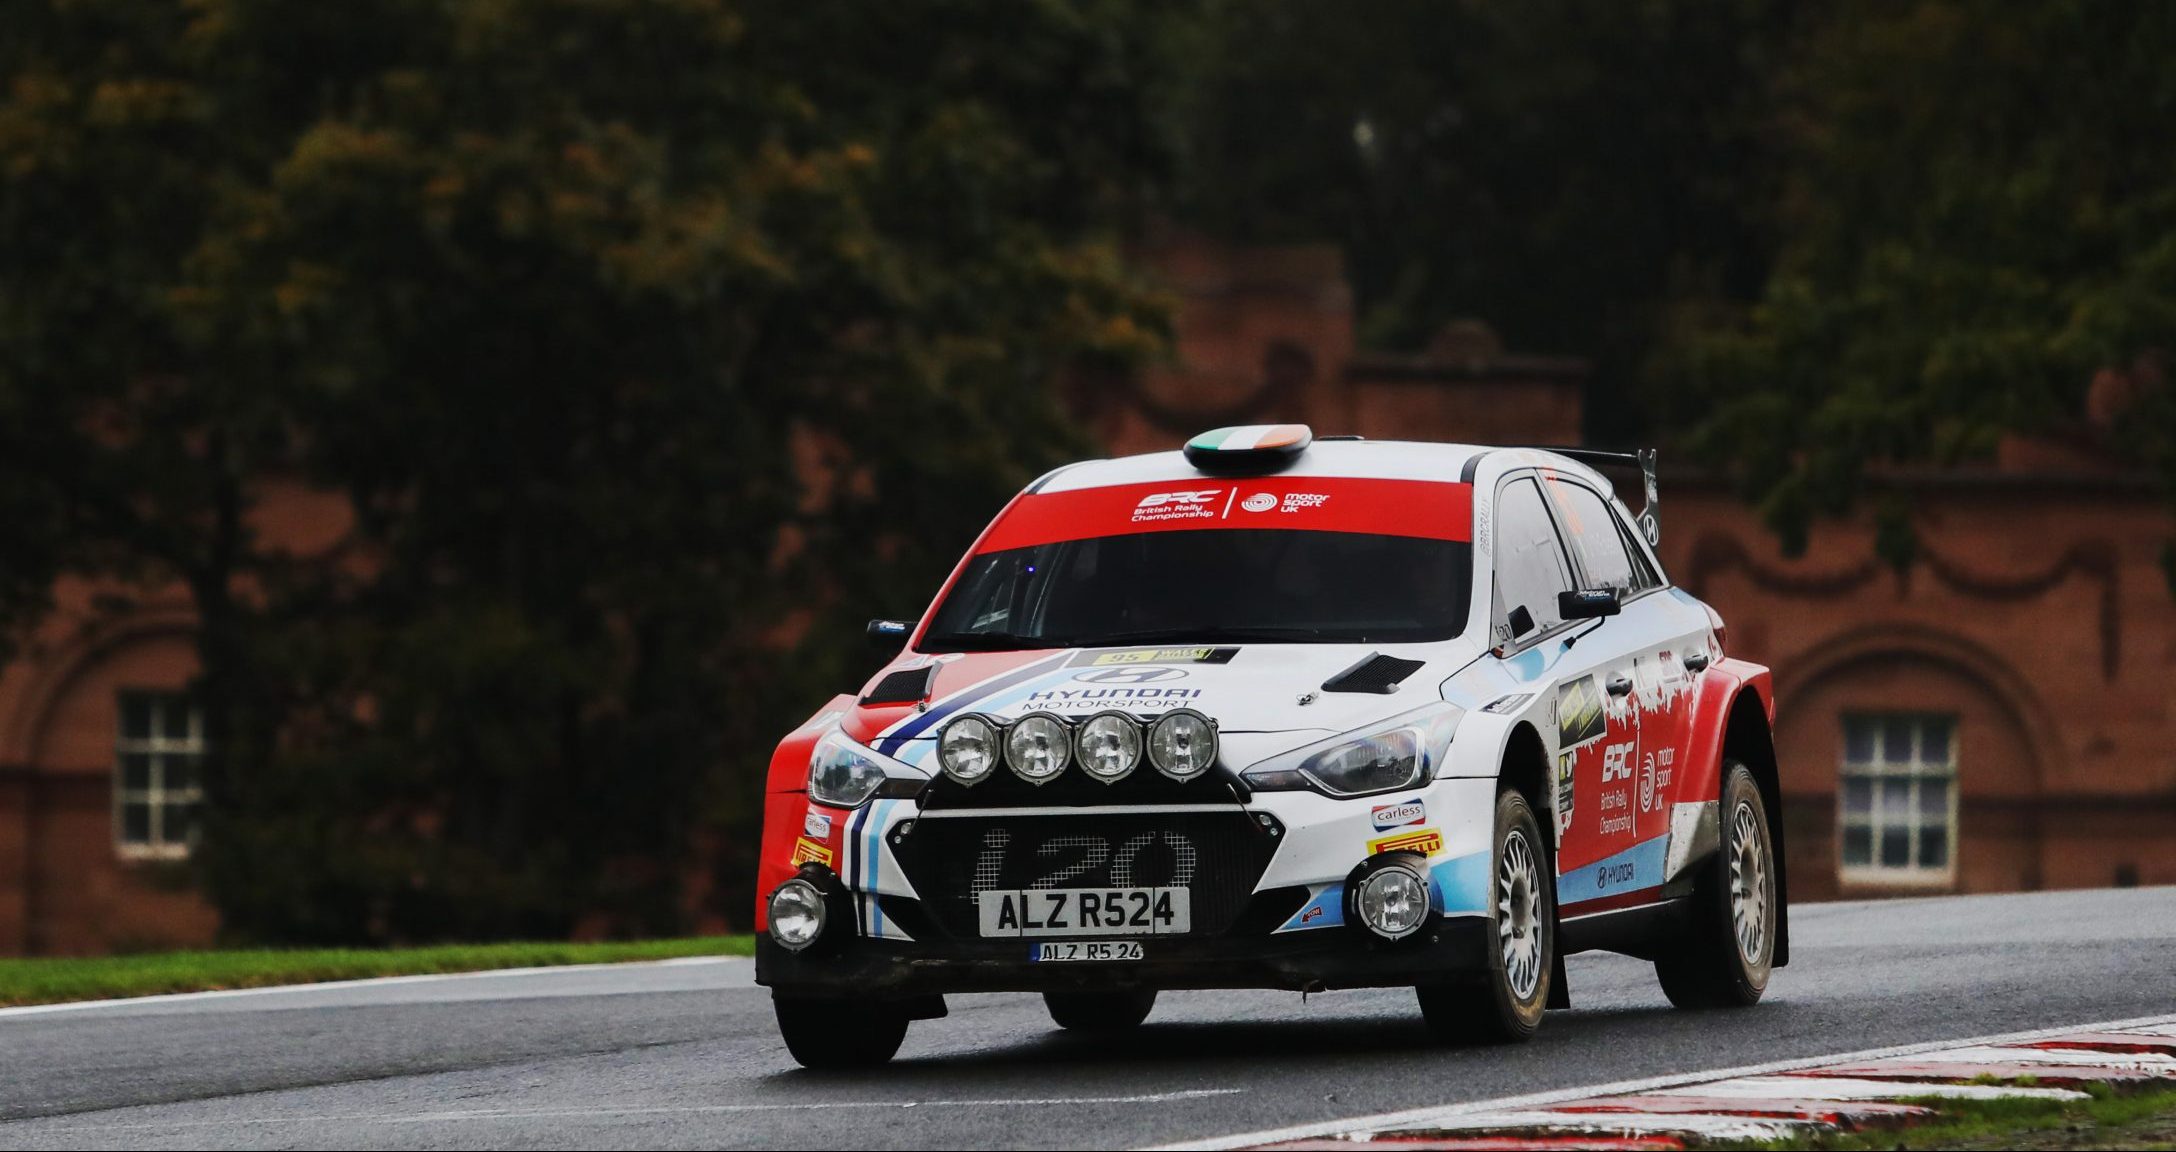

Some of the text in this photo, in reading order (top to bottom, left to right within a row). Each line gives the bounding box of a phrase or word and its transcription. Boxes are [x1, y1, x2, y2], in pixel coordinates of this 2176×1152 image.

[1138, 489, 1223, 507] BRC
[1282, 498, 1323, 508] sport
[1284, 493, 1331, 501] motor
[1131, 510, 1214, 522] Championship
[1133, 503, 1204, 515] British Rally
[1109, 653, 1140, 663] 95
[1028, 688, 1202, 700] HYUNDAI
[1022, 699, 1195, 711] MOTORSPORT
[1602, 741, 1635, 783] BRC
[1657, 746, 1675, 766] motor
[1656, 768, 1672, 791] sport
[1601, 788, 1628, 811] British Rally
[1655, 793, 1664, 812] UK
[1377, 806, 1421, 821] carless
[1600, 812, 1632, 837] Championship
[1608, 862, 1634, 885] HYUNDAI
[997, 891, 1174, 930] ALZ R524
[1041, 943, 1140, 961] ALZ R5 24
